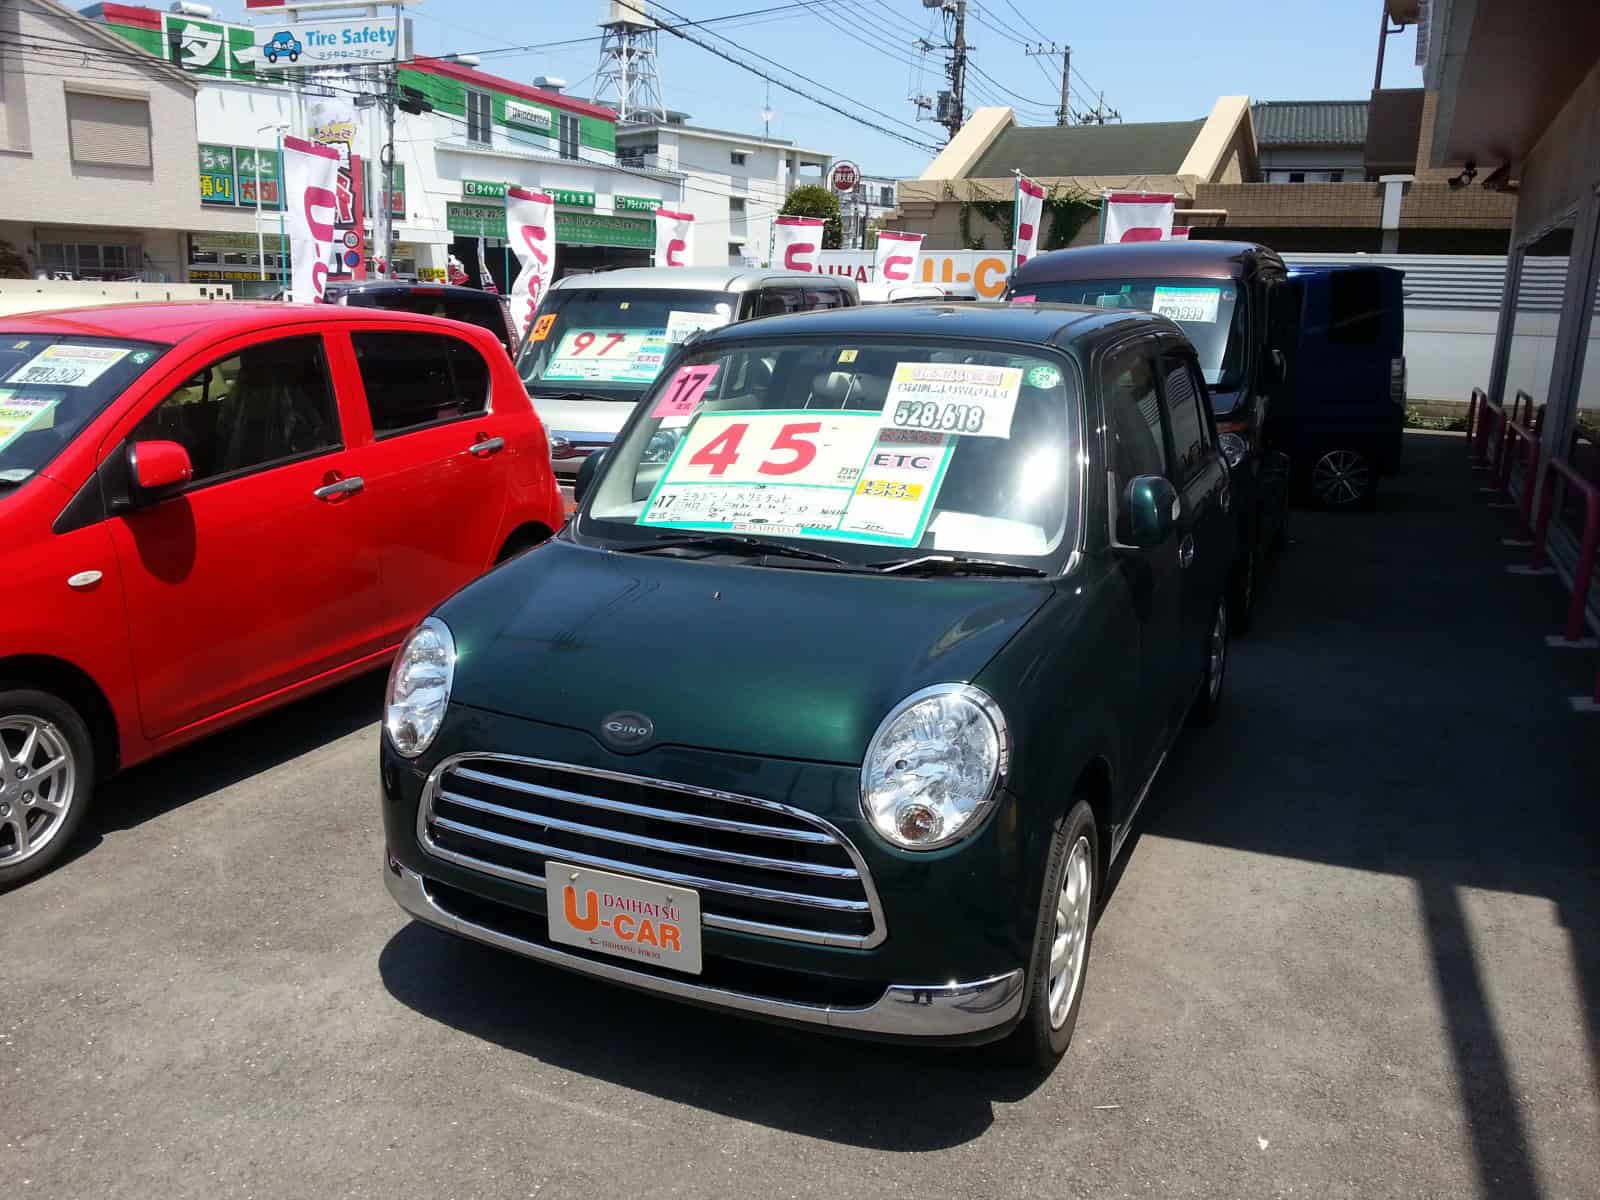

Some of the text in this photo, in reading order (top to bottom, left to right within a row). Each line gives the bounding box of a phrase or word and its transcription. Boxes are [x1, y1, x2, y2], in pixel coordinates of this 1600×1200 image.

[305, 26, 396, 46] Tire Safety
[571, 332, 627, 356] 97
[672, 373, 709, 402] 17
[894, 401, 984, 432] 528,618
[689, 422, 822, 476] 45
[873, 454, 930, 469] ETC
[607, 721, 648, 735] GINO
[564, 885, 681, 953] U-CAR
[603, 893, 681, 922] DAIHATSU
